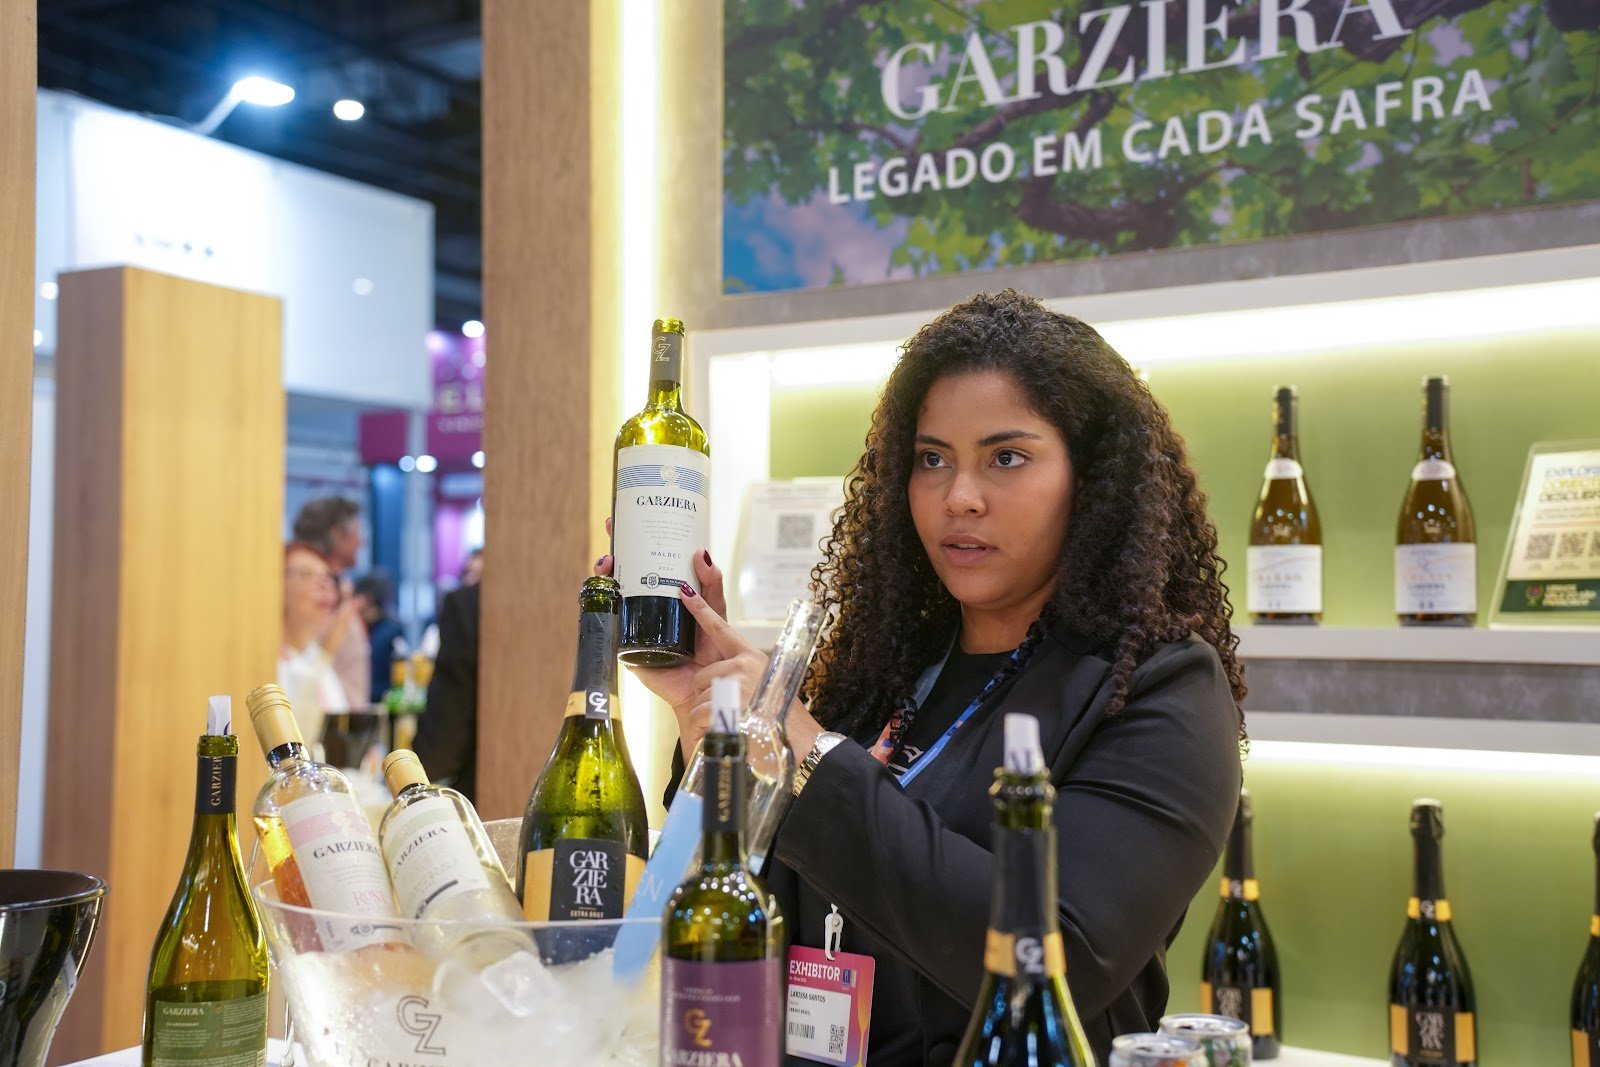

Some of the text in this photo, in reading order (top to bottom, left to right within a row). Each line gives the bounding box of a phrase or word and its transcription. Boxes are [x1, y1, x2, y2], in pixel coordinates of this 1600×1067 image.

[881, 0, 1413, 121] GARZIERA
[828, 68, 1493, 205] LEGADO EM CADA SAFRA
[653, 335, 672, 362] GZ
[636, 495, 697, 513] GARZIERA
[650, 551, 681, 560] MALBEC
[588, 691, 608, 714] GZ
[569, 850, 610, 871] GAR
[571, 868, 608, 889] ZIE
[573, 885, 604, 906] RA
[1015, 936, 1044, 974] GZ
[789, 959, 841, 982] EXHIBITOR
[790, 990, 808, 1000] LARISSA
[808, 993, 826, 1003] SANTOS
[162, 1007, 205, 1016] GARZIERA
[396, 994, 447, 1056] GZ
[684, 1007, 714, 1048] GZ
